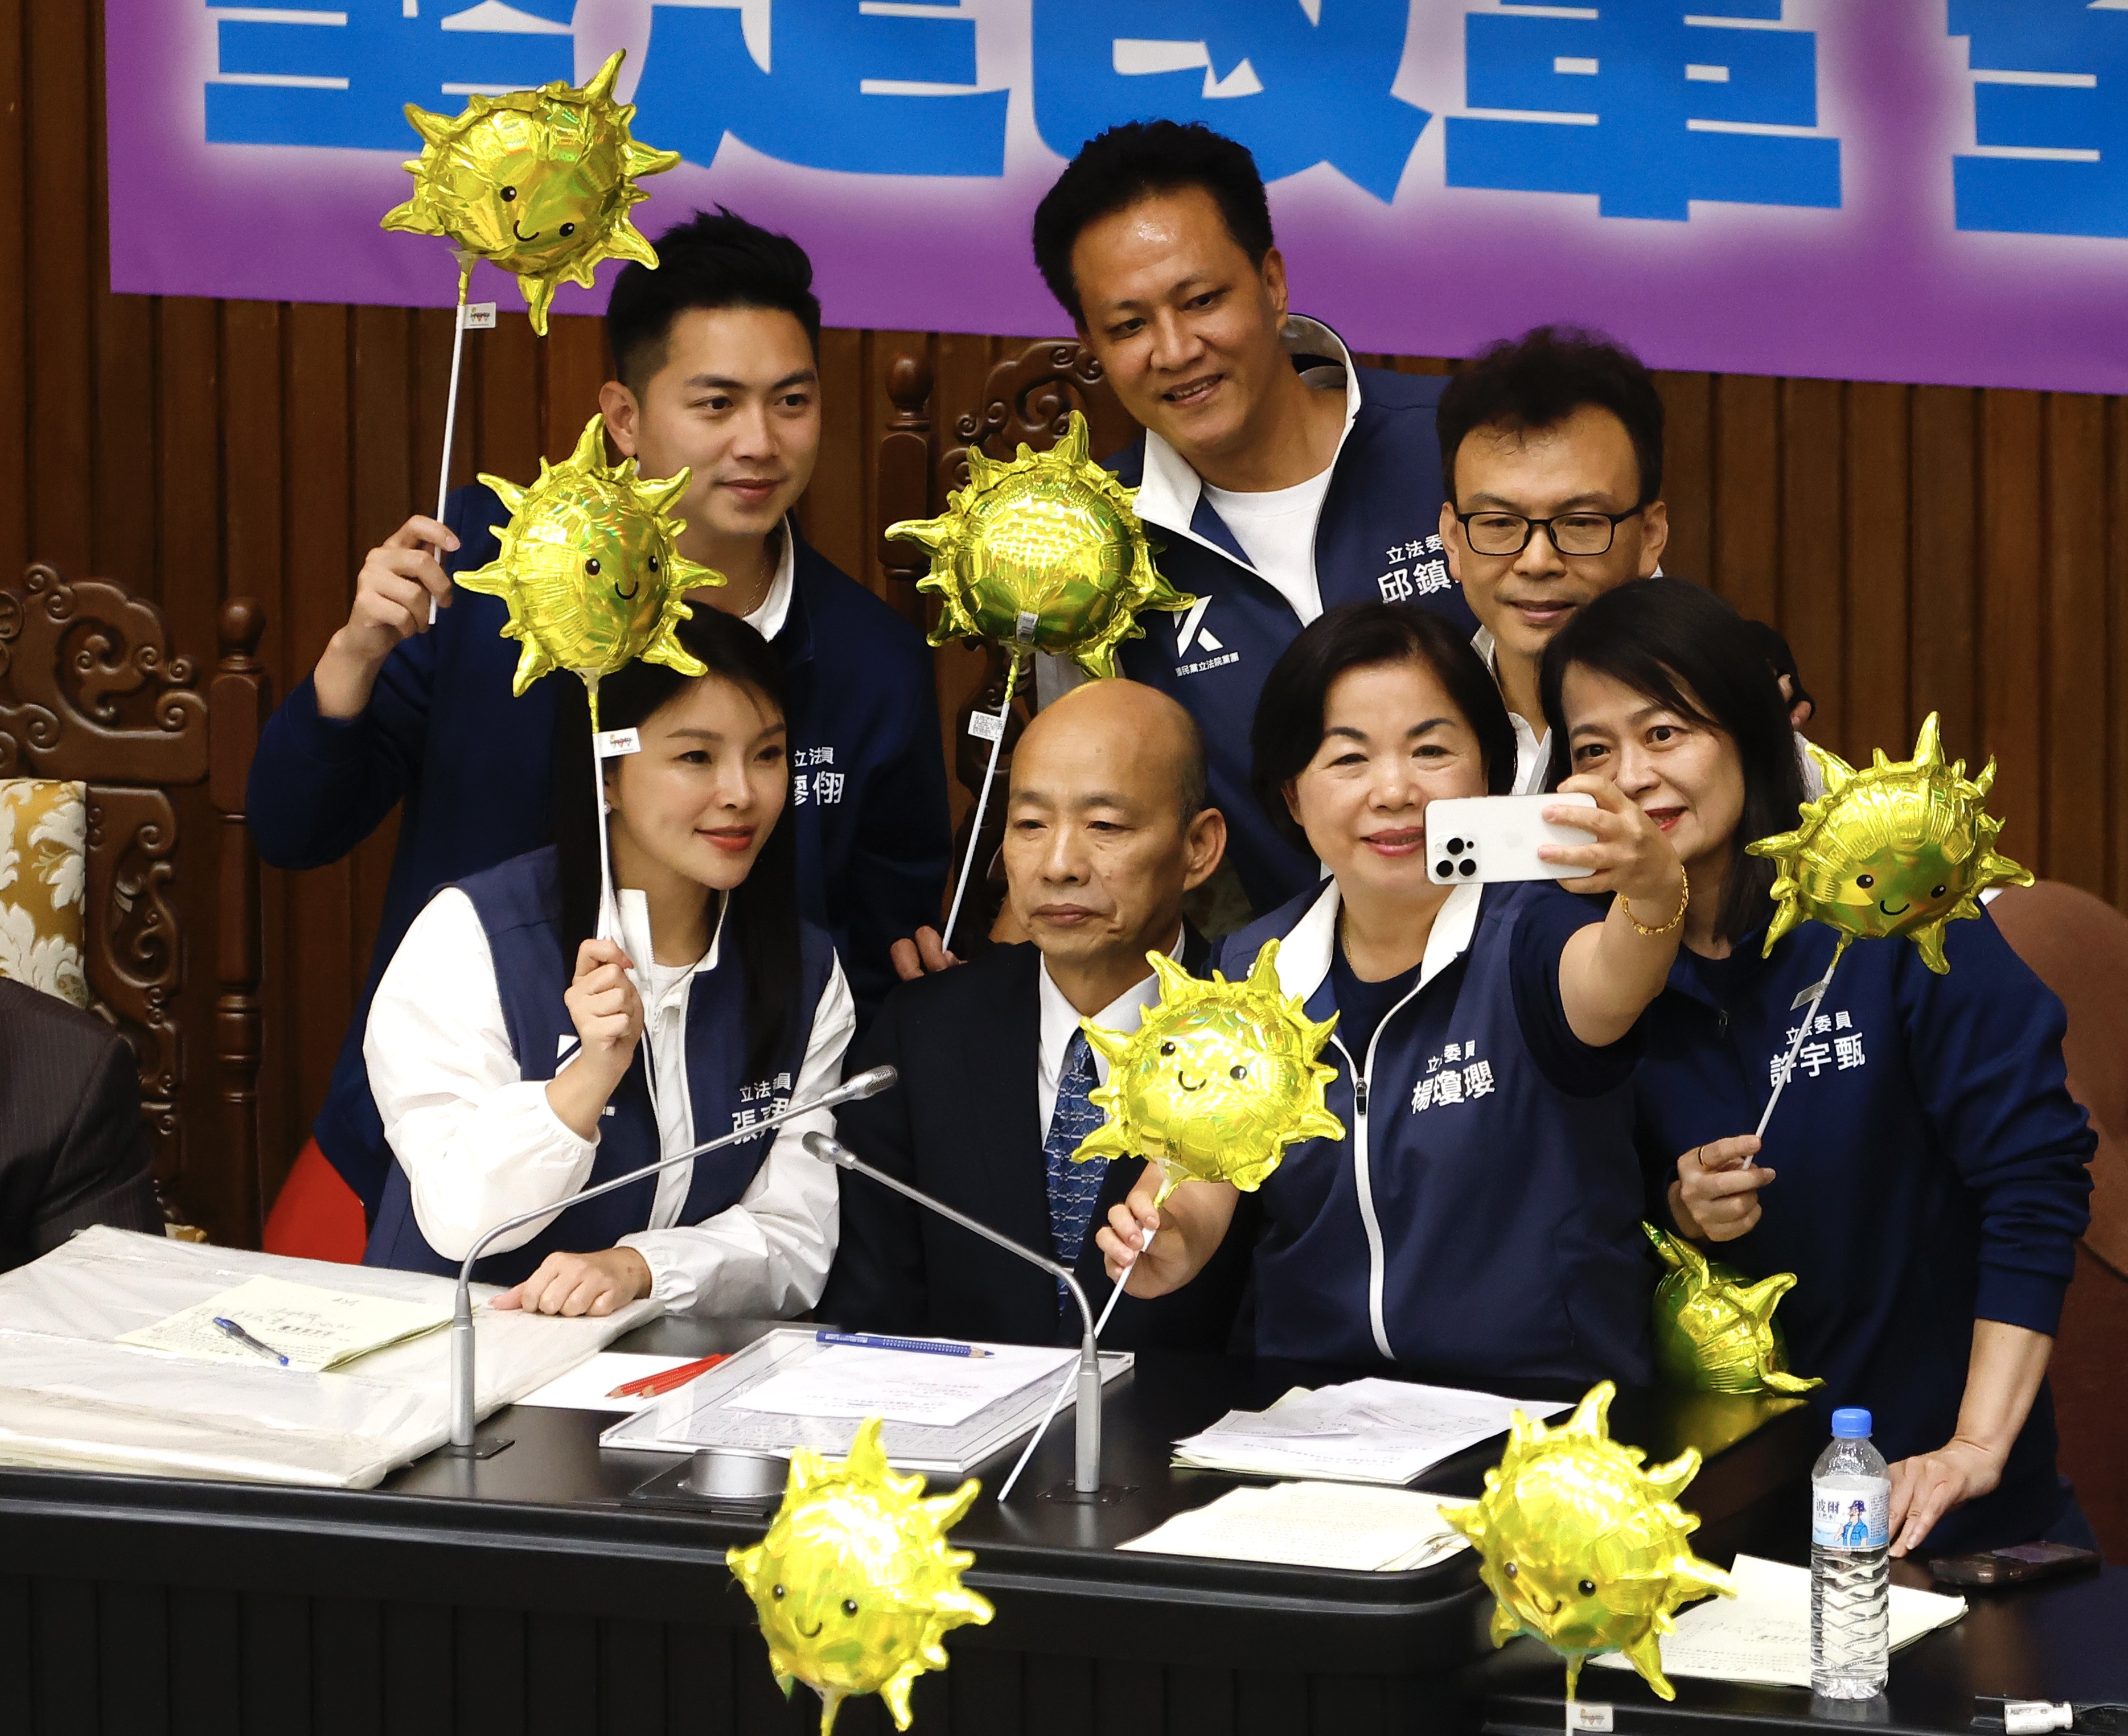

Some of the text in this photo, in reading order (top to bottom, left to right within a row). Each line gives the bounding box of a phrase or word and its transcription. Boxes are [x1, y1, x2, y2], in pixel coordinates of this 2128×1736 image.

[1377, 559, 1460, 604] 邱鎮
[1425, 1039, 1476, 1074] 立委員
[1769, 1032, 1866, 1088] 許宇甄
[739, 1072, 792, 1103] 立法員
